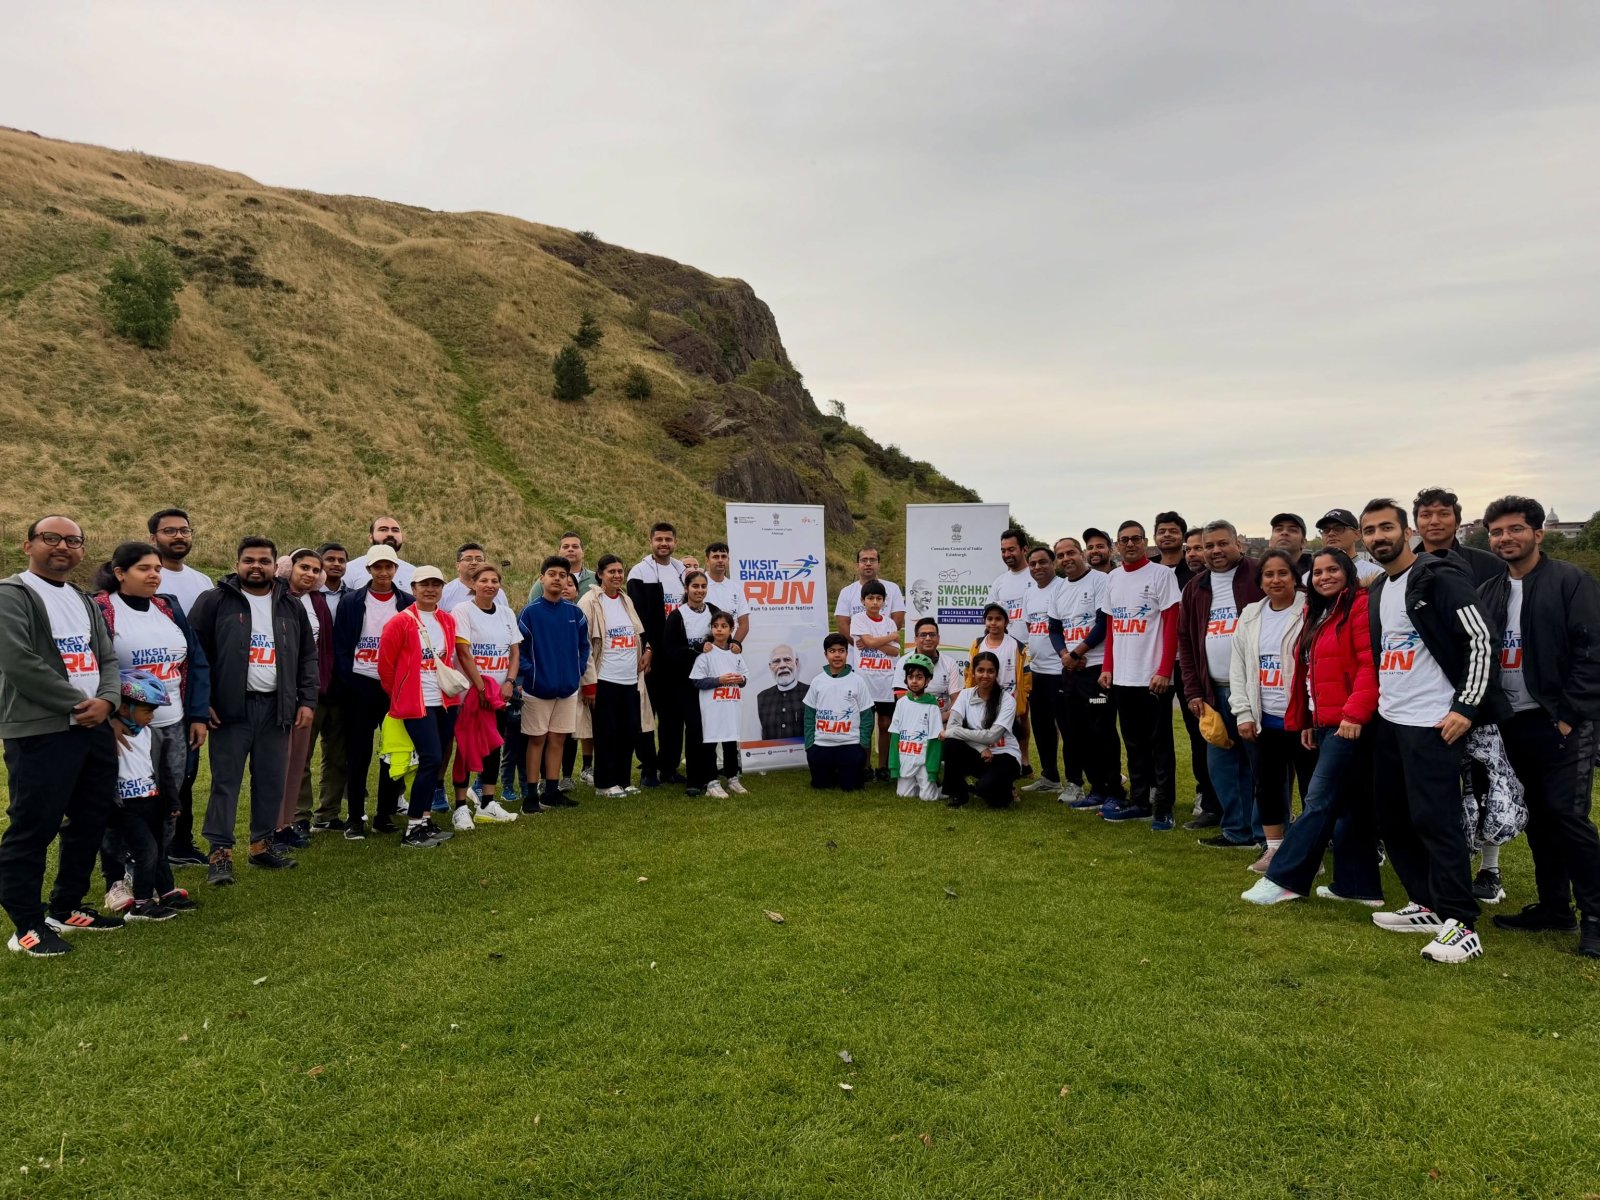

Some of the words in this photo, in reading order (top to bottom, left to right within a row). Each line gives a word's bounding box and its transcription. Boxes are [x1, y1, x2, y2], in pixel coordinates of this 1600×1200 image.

[739, 560, 779, 570] VIKSIT
[740, 570, 790, 580] BHARAT
[743, 581, 815, 604] RUN
[938, 584, 992, 595] SWACHHA
[937, 596, 948, 606] HI
[951, 596, 977, 606] SEVA
[1207, 620, 1238, 635] RU
[131, 648, 168, 657] VIKSIT
[249, 647, 276, 664] RU
[61, 653, 98, 672] RU
[132, 655, 177, 665] BHARAT
[474, 656, 509, 670] RUN
[858, 658, 892, 669] RUN
[1380, 650, 1415, 670] UN
[713, 687, 741, 700] RUN
[816, 719, 852, 733] RUN
[898, 741, 923, 755] UN
[115, 777, 143, 789] IKSIT
[118, 783, 153, 798] HARAT
